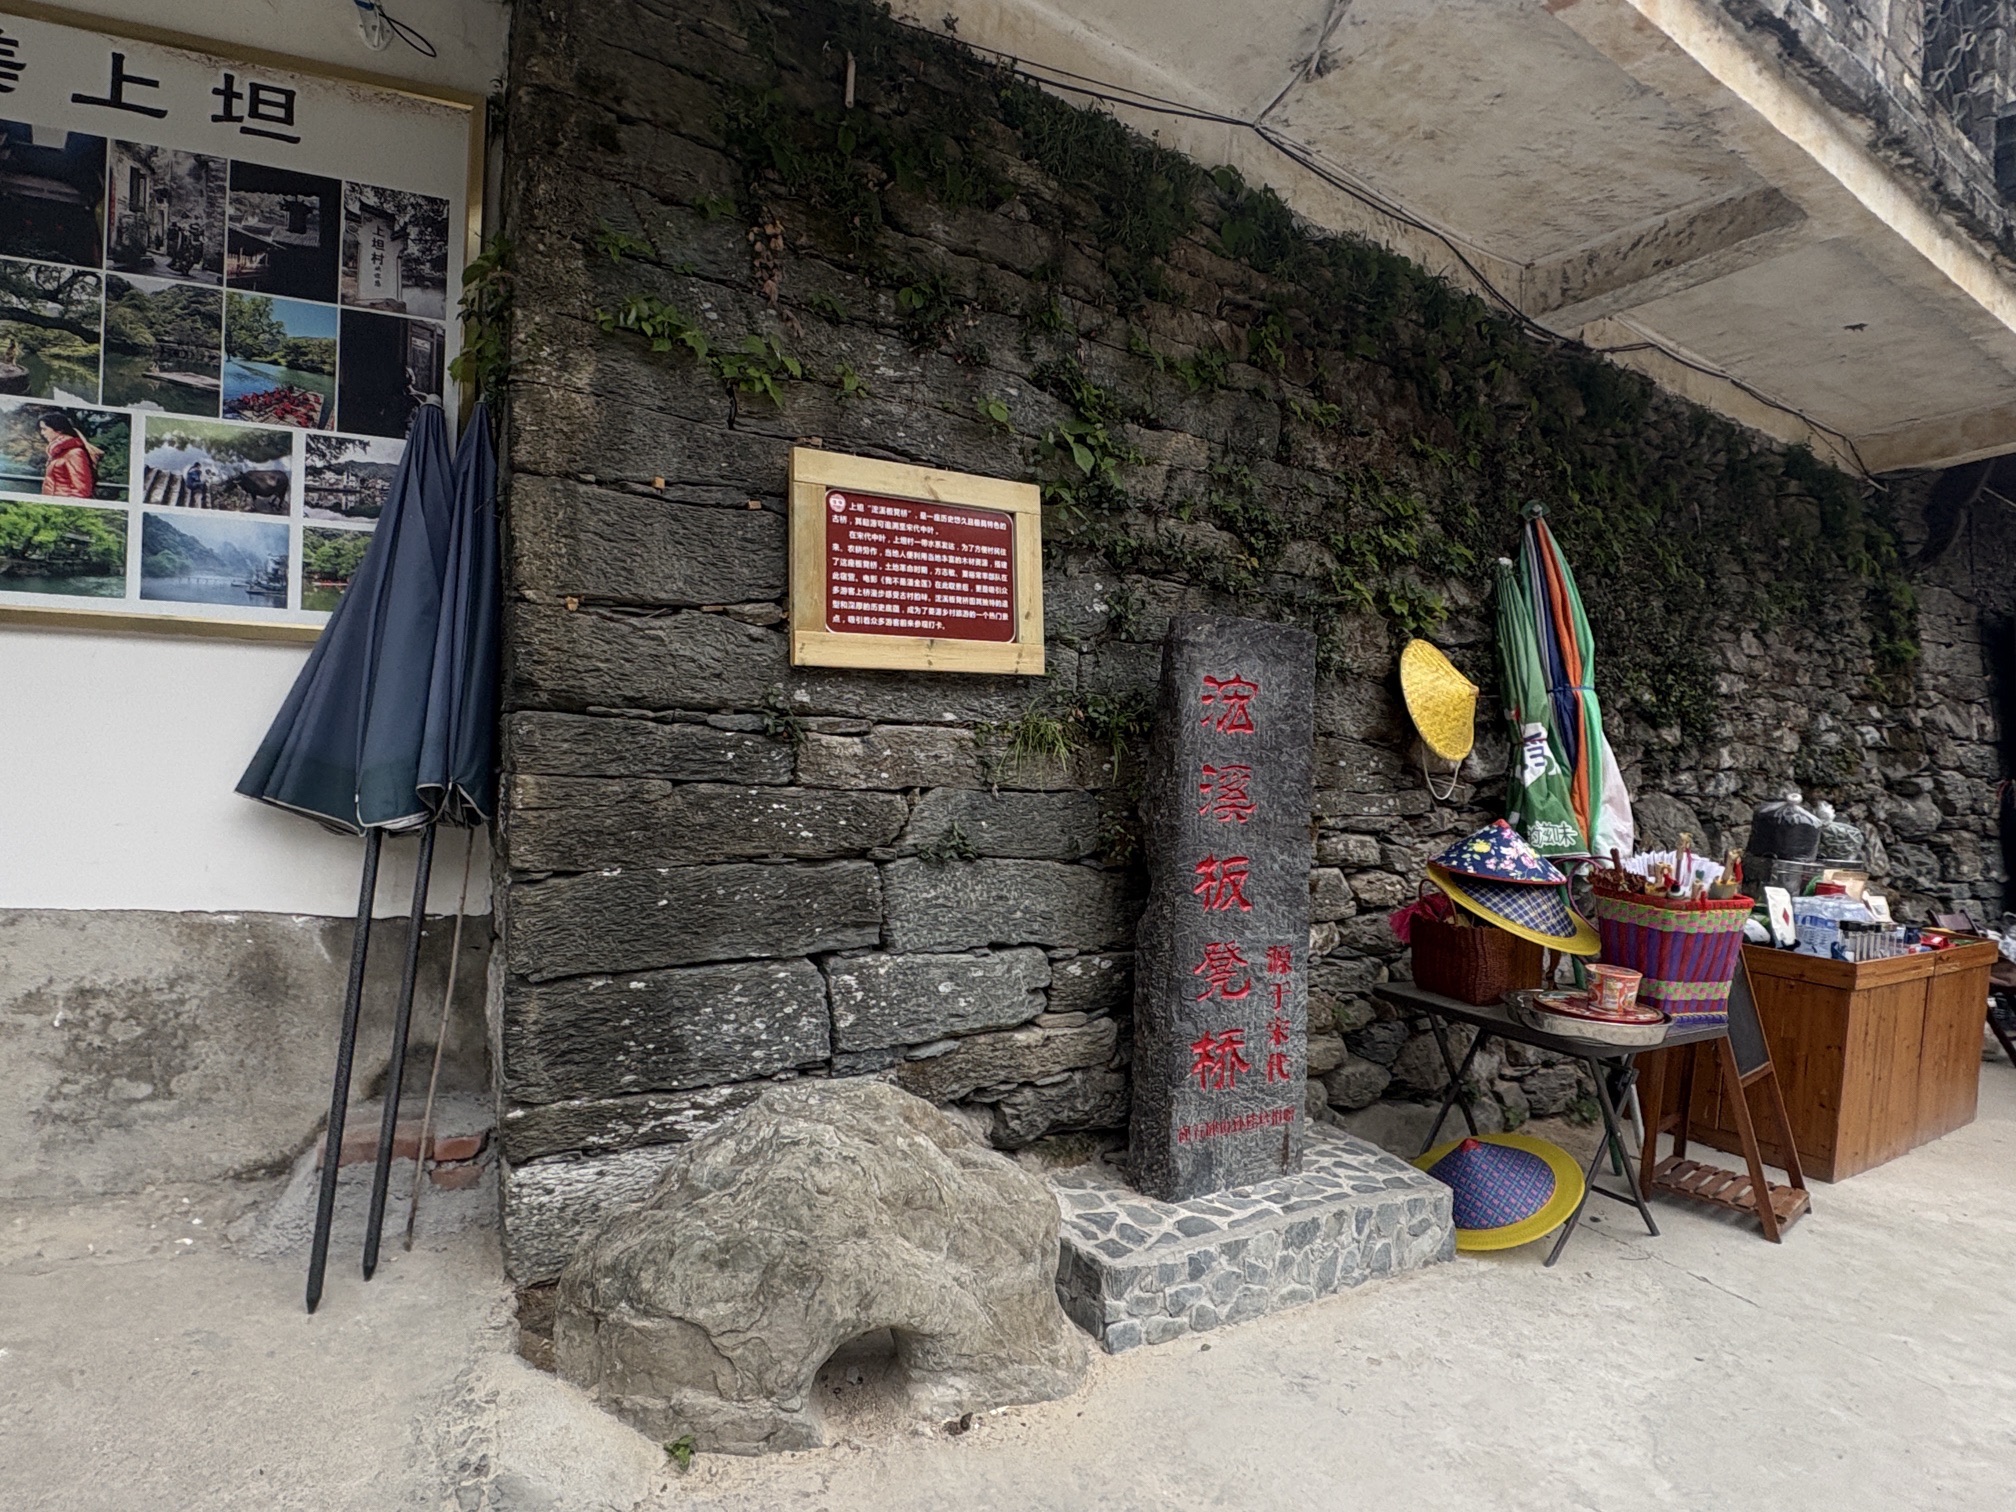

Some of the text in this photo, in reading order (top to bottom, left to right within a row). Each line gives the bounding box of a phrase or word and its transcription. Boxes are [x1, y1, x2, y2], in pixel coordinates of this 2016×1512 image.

[371, 224, 386, 266] 上坦村
[1265, 944, 1294, 1084] 源于宋代
